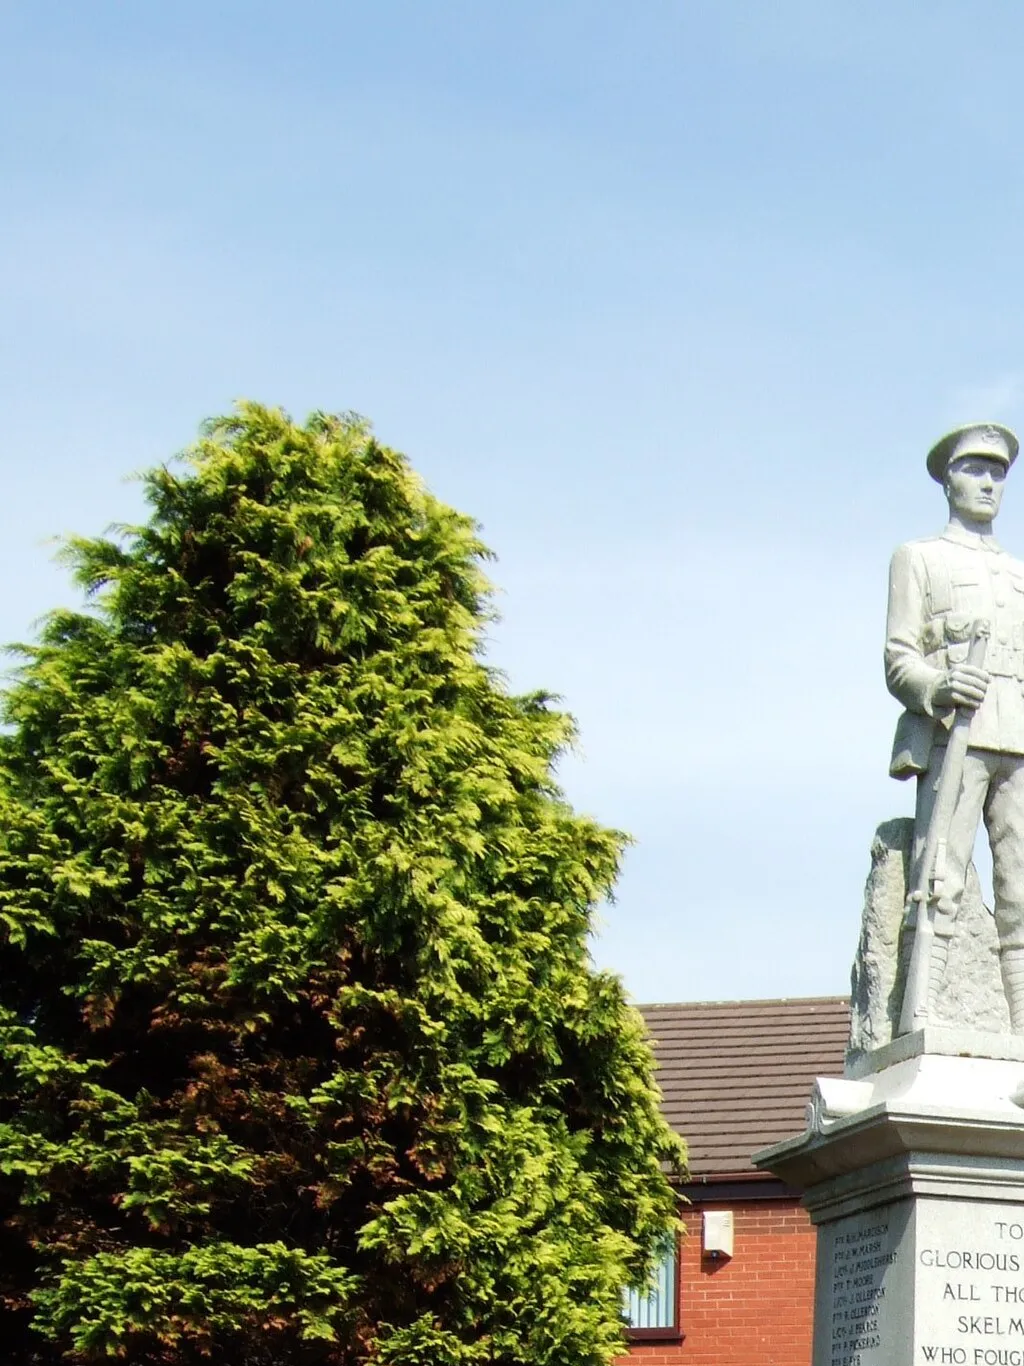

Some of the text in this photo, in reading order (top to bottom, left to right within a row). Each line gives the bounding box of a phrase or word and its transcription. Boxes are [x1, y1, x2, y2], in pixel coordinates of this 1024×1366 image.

[995, 1222, 1023, 1240] TO
[920, 1250, 1019, 1270] GLORIOUS
[943, 1284, 980, 1300] ALL
[922, 1346, 966, 1364] WHO
